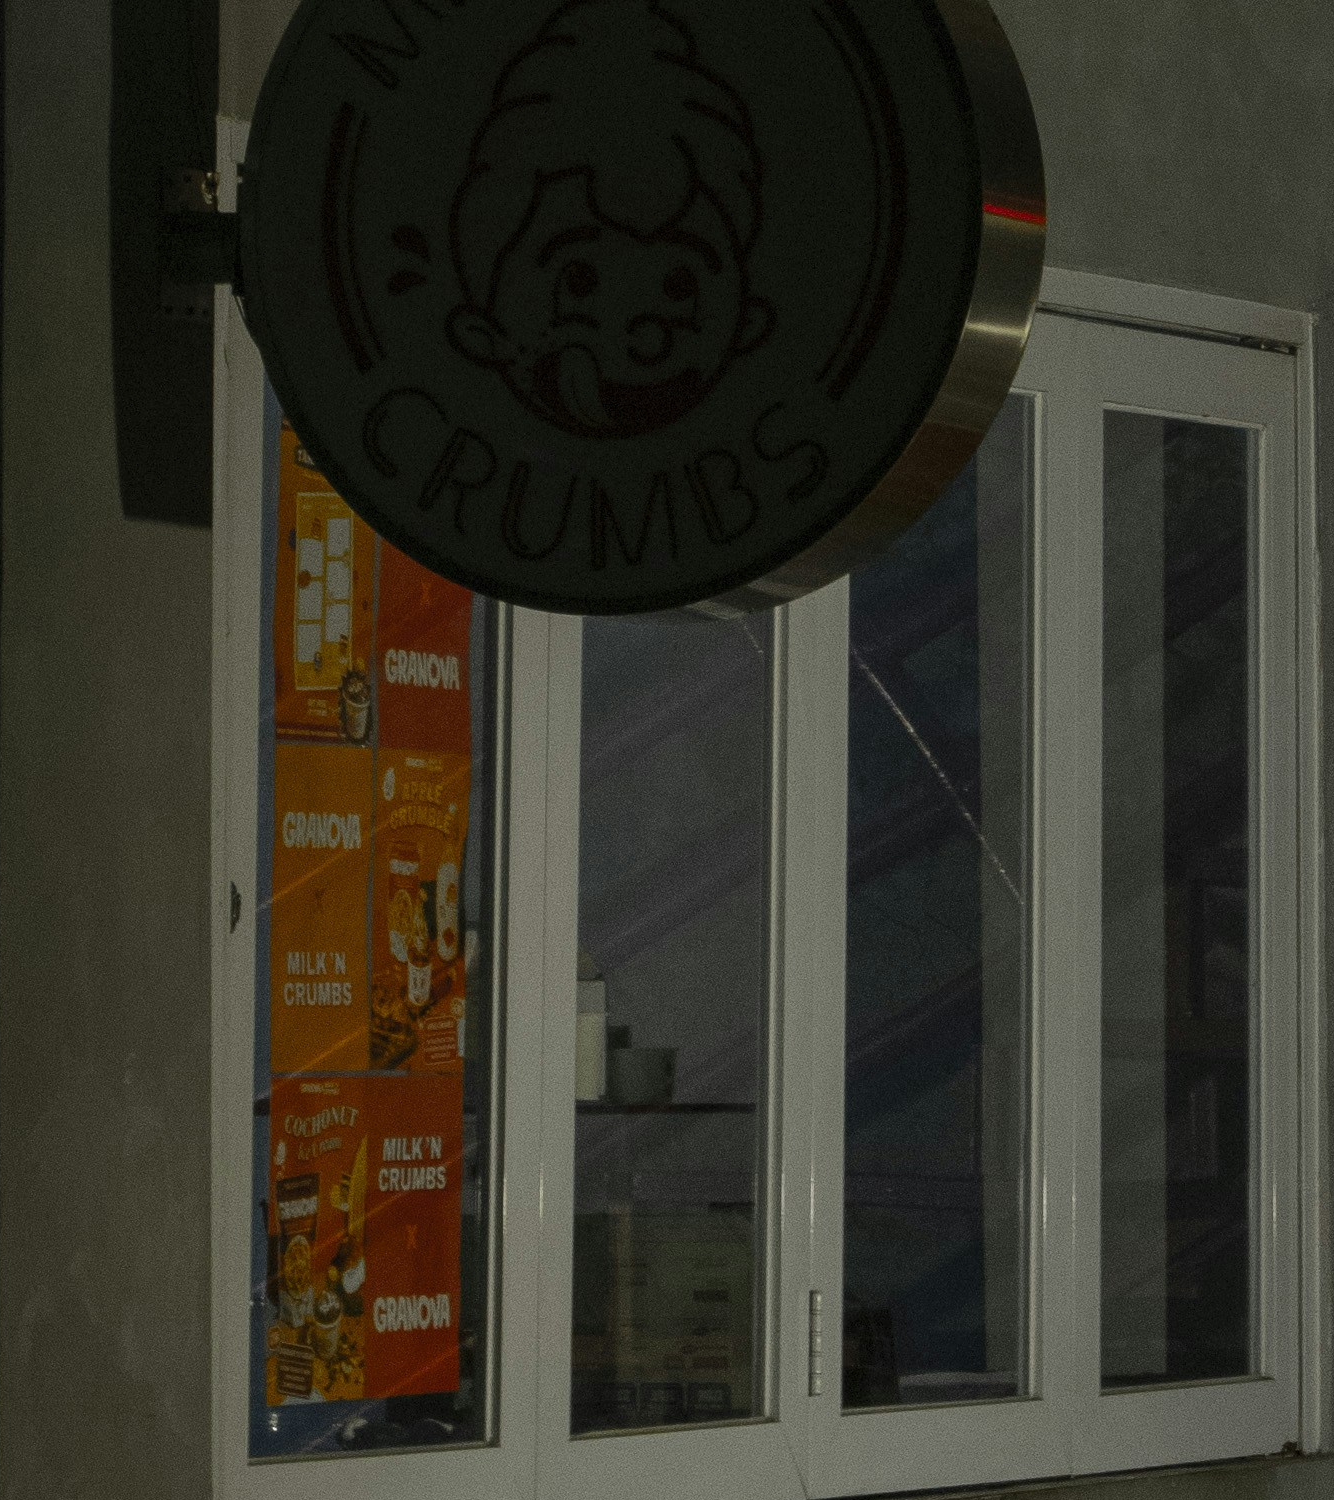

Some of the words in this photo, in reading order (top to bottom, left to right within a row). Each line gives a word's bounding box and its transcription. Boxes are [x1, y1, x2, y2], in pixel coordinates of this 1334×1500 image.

[361, 386, 829, 571] CRUMBS
[384, 648, 461, 690] GRANOVA
[282, 811, 363, 850] GRANOVA
[283, 981, 353, 1006] CRUMBS
[378, 1165, 447, 1192] CRUMBS
[372, 1293, 452, 1333] GRANOVA
